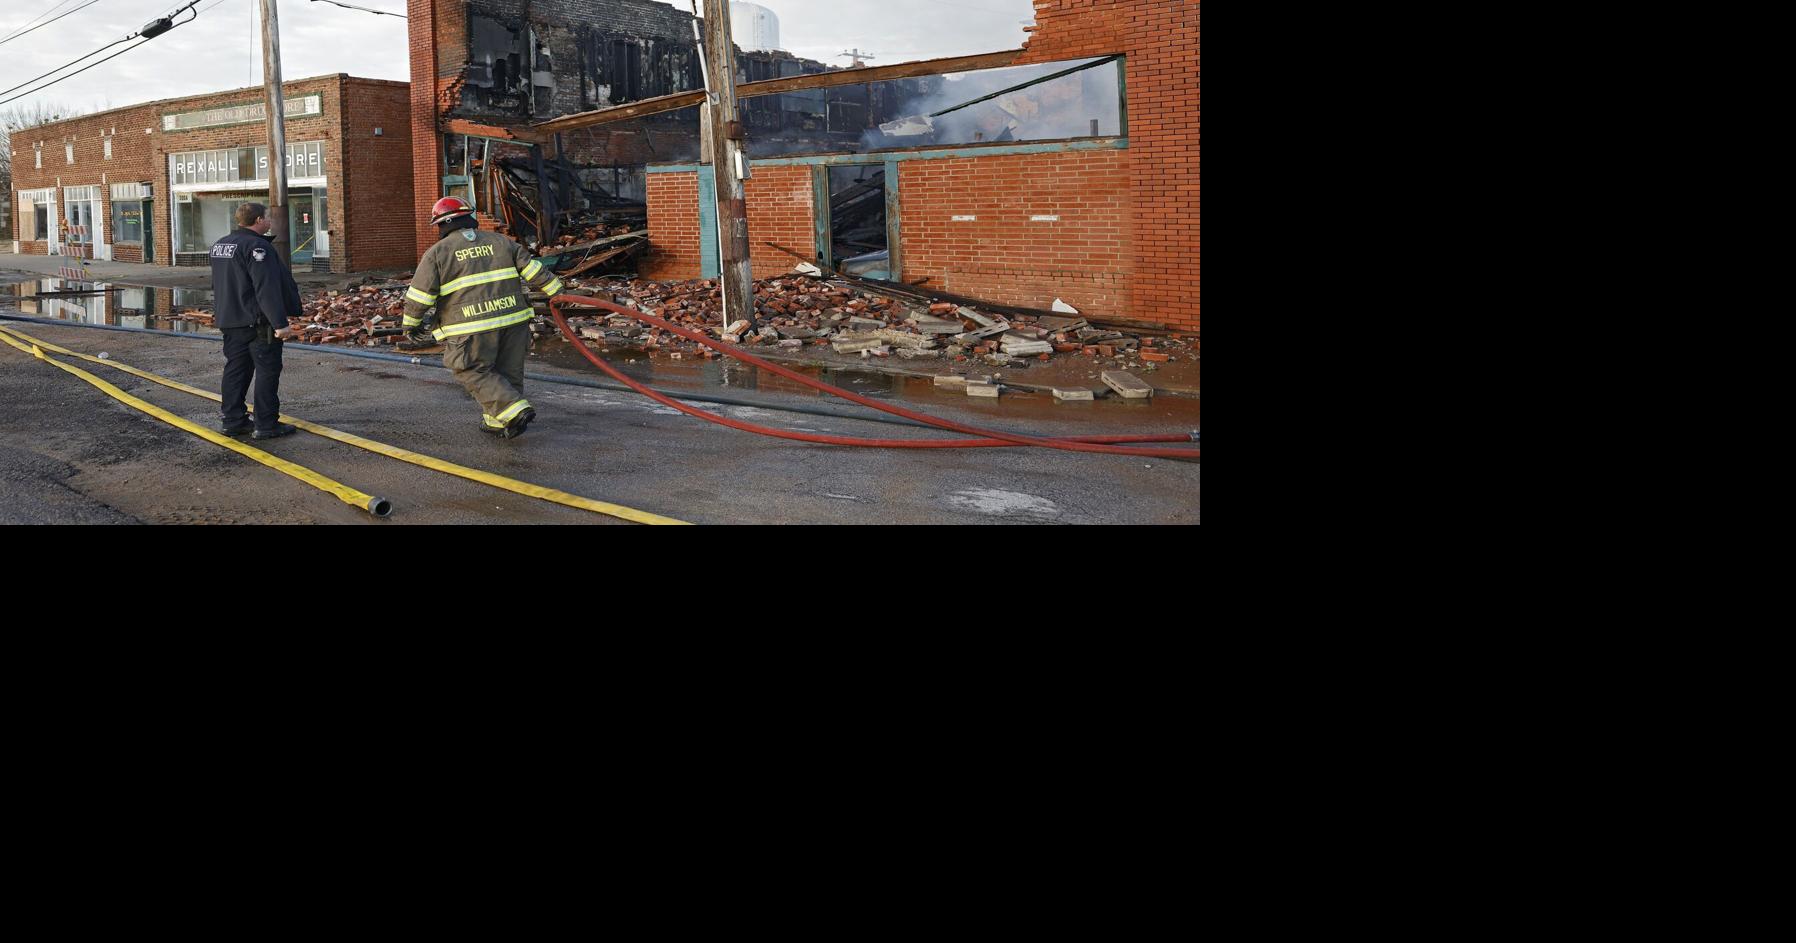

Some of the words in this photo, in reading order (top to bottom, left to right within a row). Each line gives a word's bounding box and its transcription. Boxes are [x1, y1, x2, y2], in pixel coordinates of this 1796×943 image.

[206, 110, 224, 122] THE
[244, 106, 266, 118] DRU
[176, 160, 238, 174] REXALL
[259, 153, 317, 169] SORE
[212, 245, 235, 257] POLICE
[455, 244, 494, 262] SPERRY
[461, 295, 517, 318] WILLIAMSON
